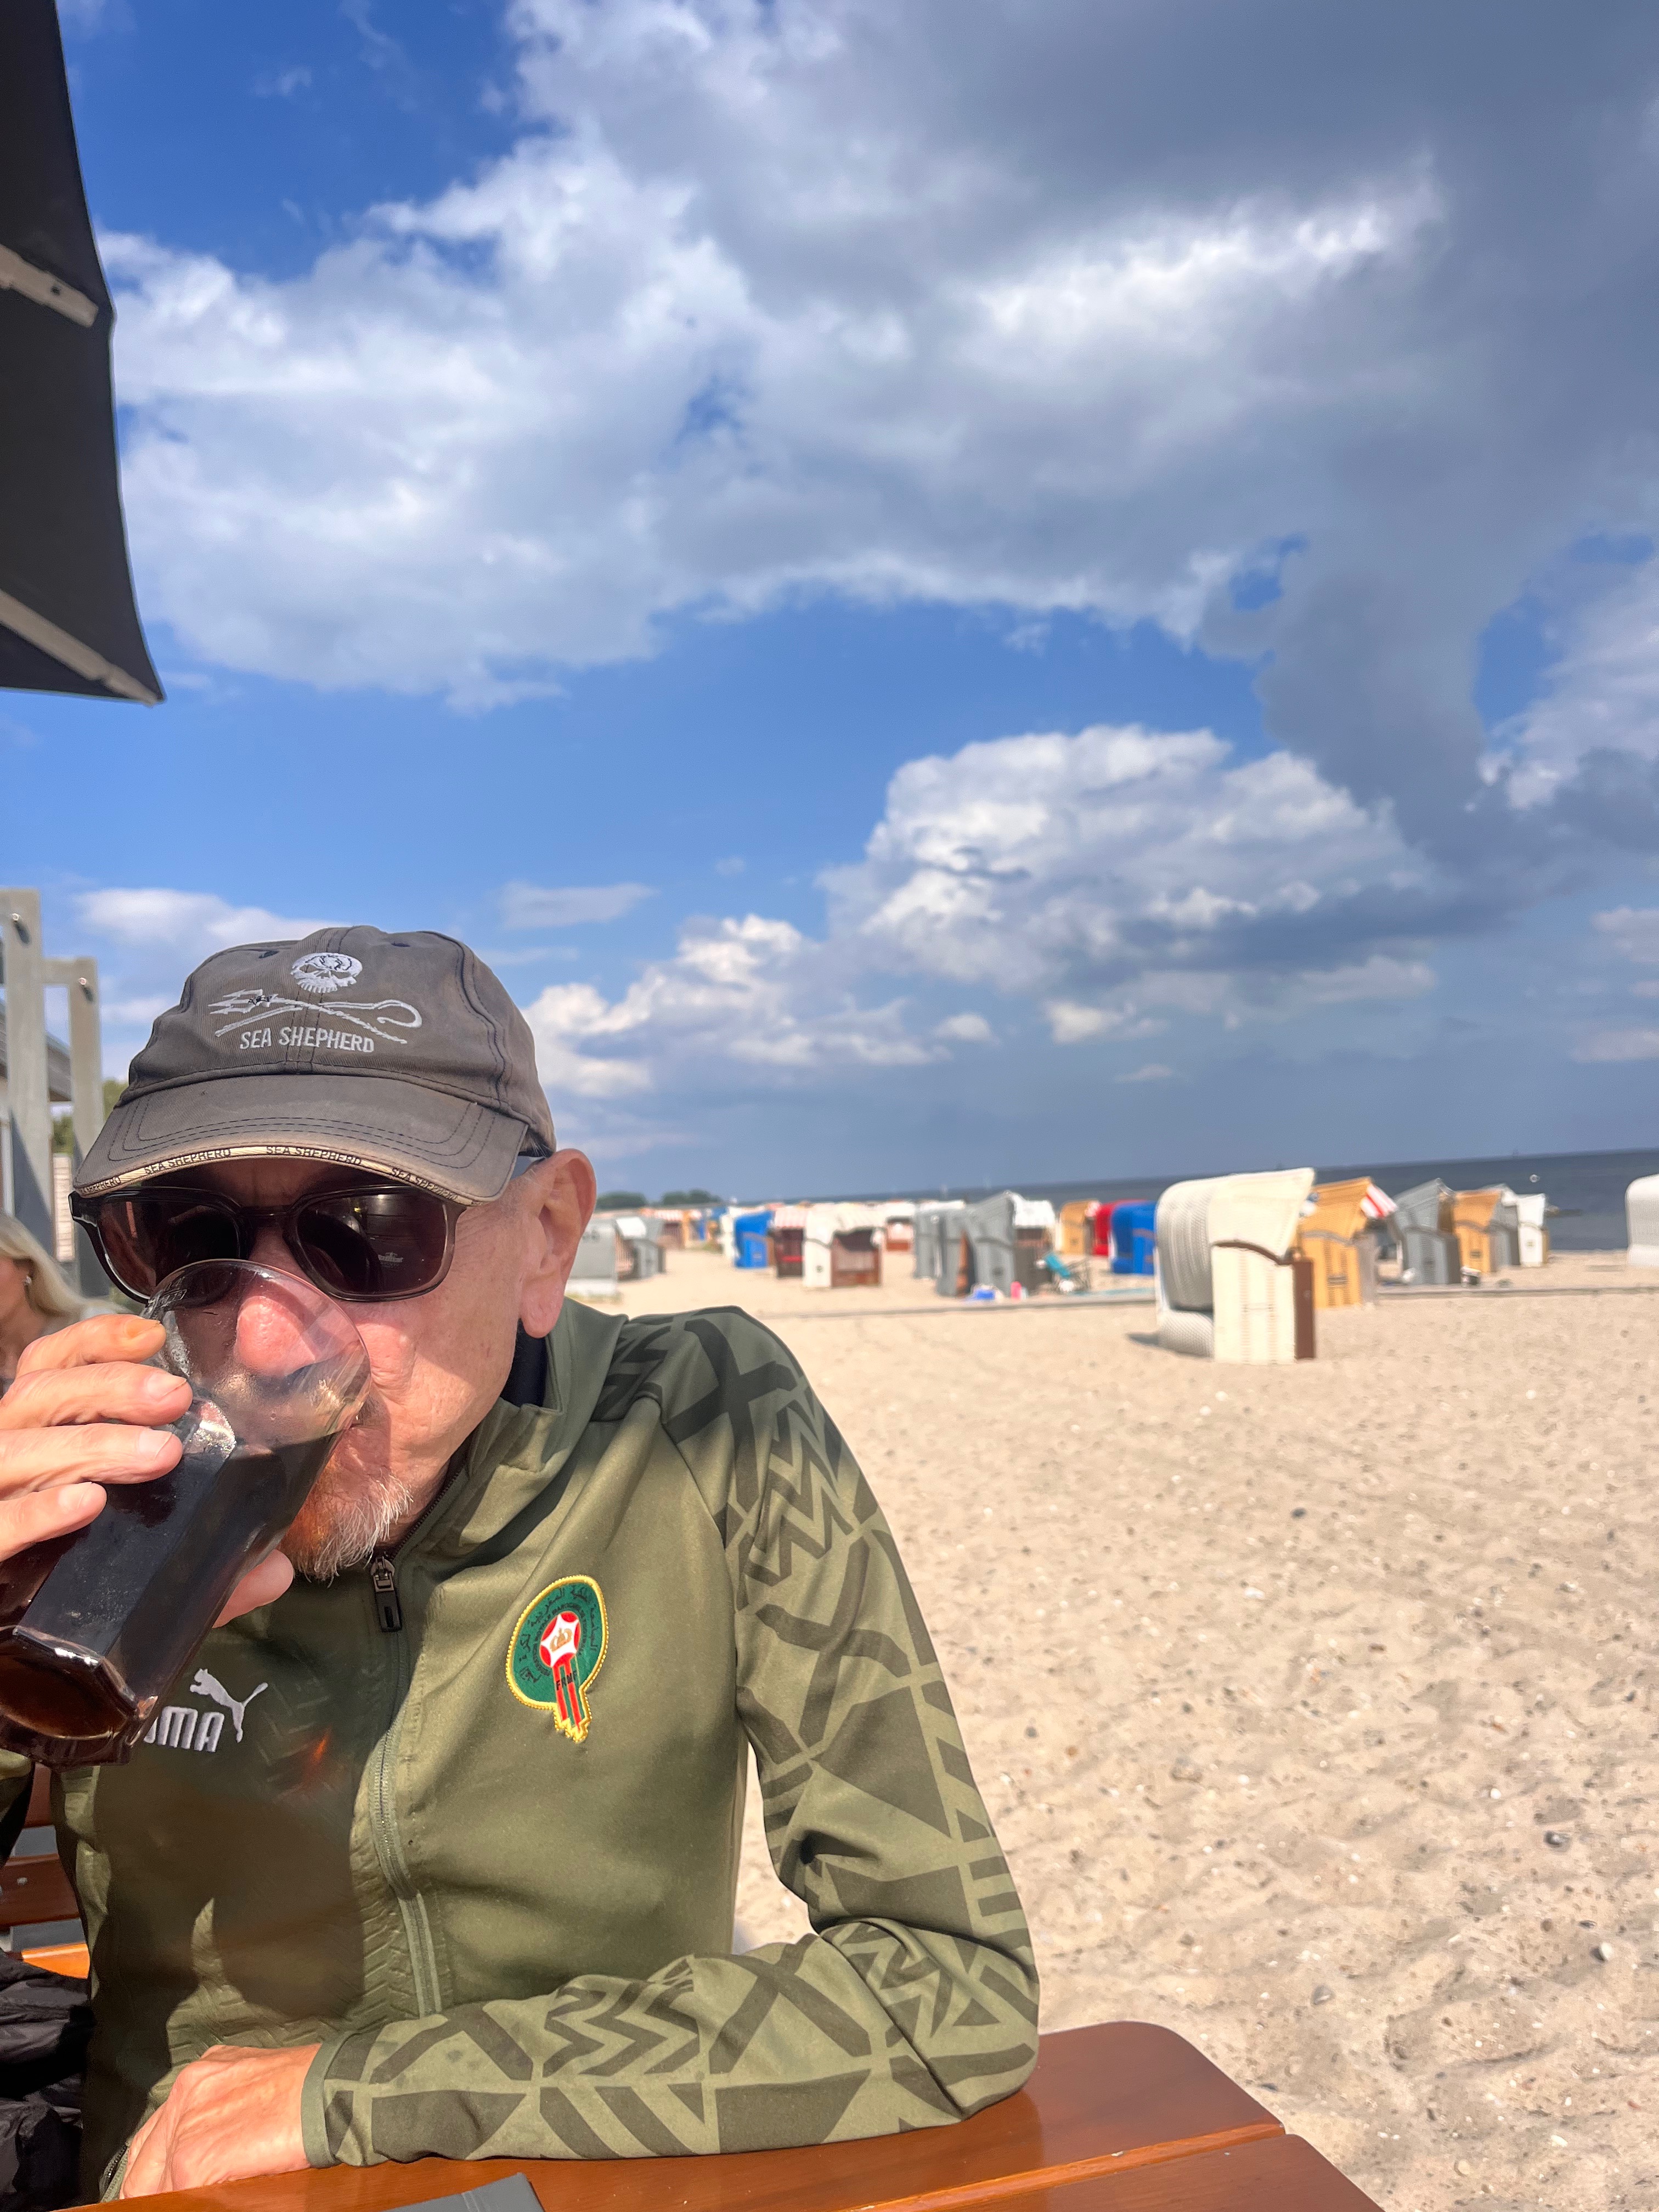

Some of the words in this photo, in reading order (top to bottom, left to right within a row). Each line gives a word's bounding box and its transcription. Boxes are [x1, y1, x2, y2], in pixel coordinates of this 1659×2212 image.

[240, 1027, 272, 1050] SEA
[278, 1025, 375, 1053] SHEPHERD
[144, 1164, 167, 1175] SEA
[168, 1148, 232, 1168] SHEPHERD
[266, 1146, 291, 1155] SEA
[295, 1147, 362, 1166] SHEPHERD
[392, 1167, 413, 1181] SEA
